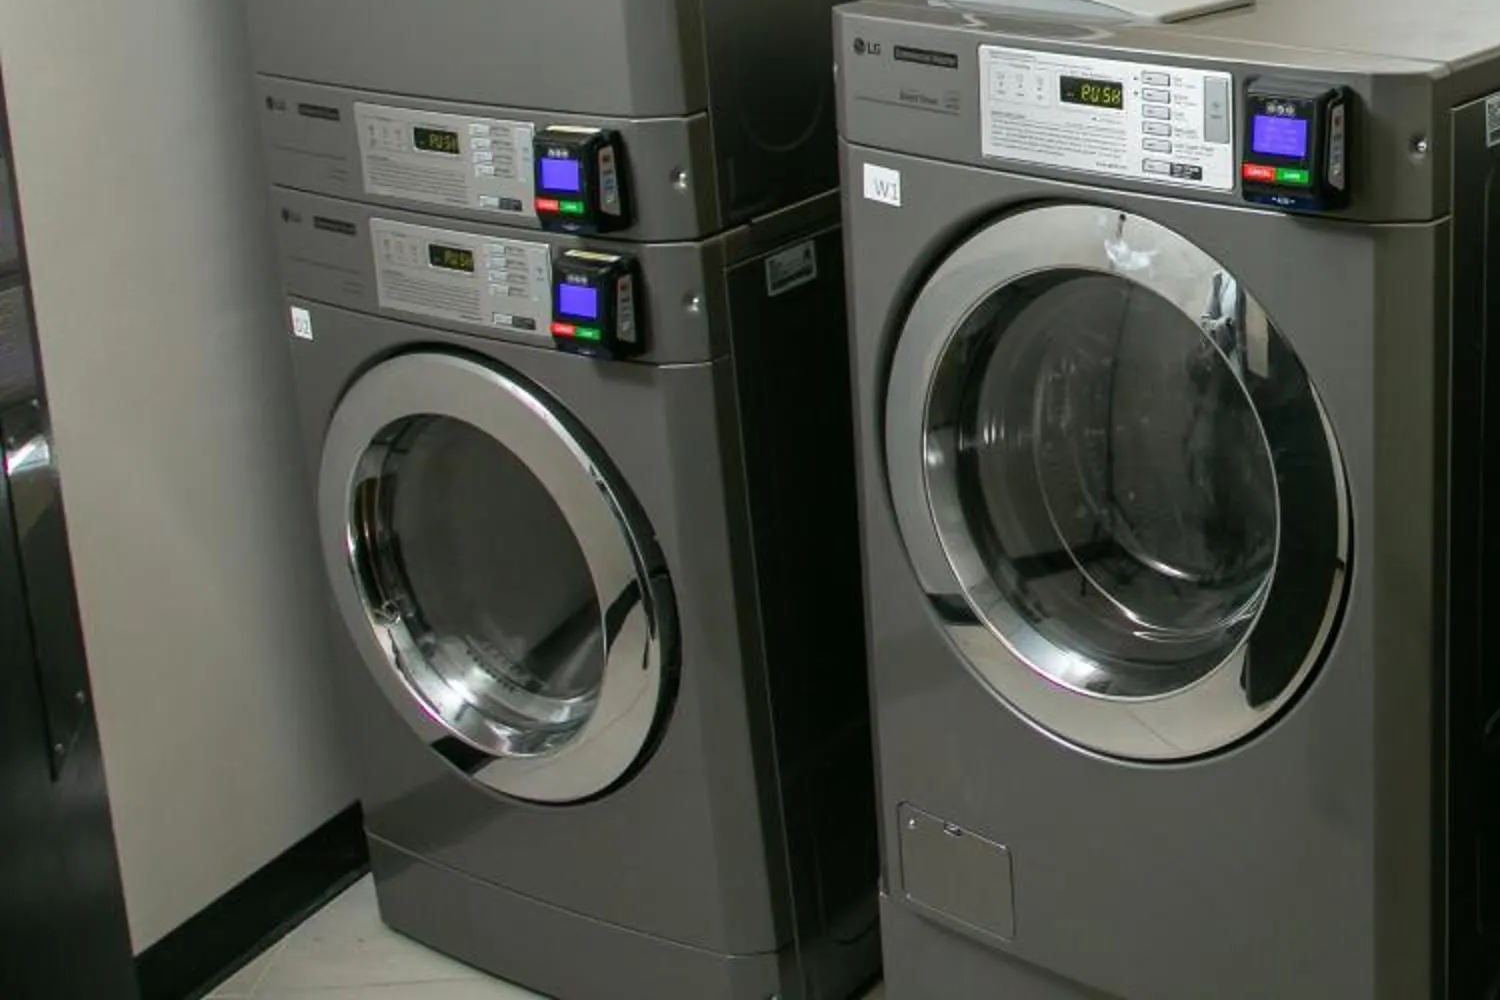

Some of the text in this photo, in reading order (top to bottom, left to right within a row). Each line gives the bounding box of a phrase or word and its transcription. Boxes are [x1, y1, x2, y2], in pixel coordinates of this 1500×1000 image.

[867, 43, 881, 55] LG
[1080, 83, 1122, 104] PUSH
[873, 178, 898, 201] W1
